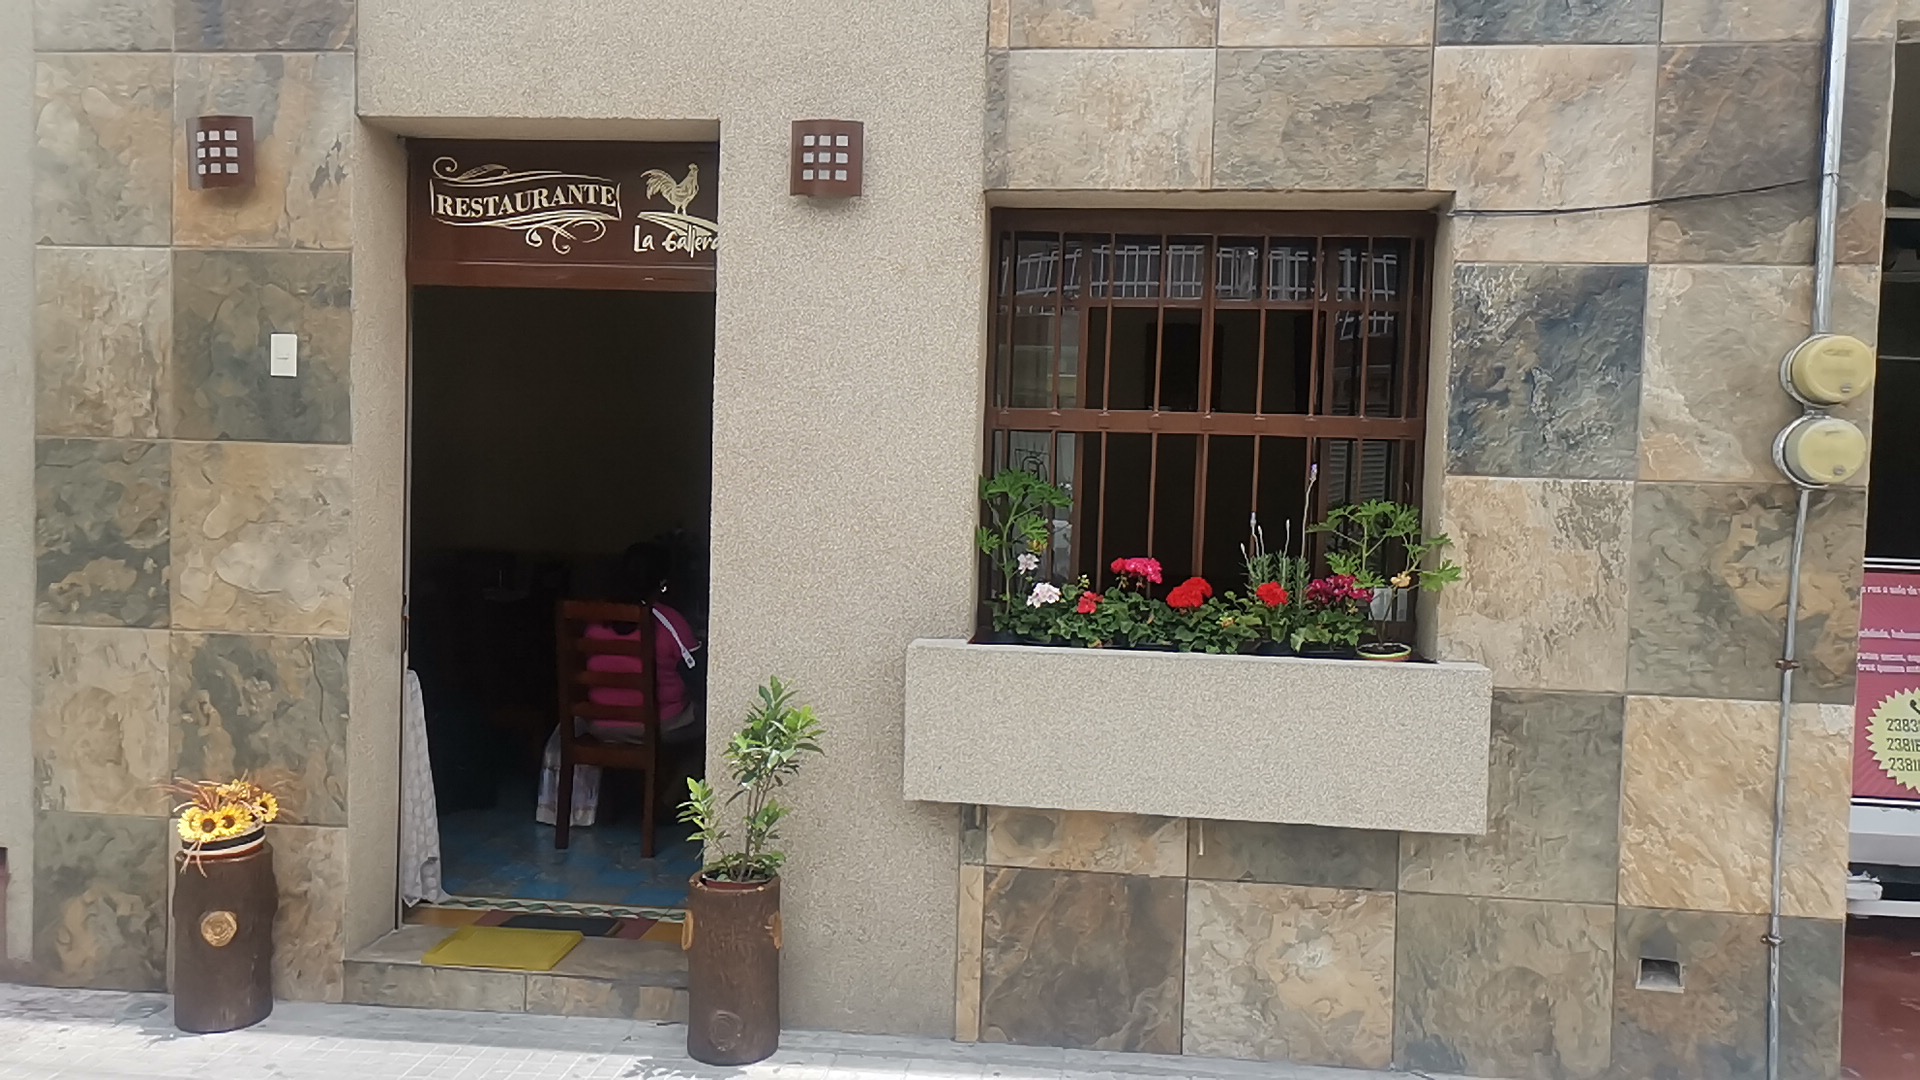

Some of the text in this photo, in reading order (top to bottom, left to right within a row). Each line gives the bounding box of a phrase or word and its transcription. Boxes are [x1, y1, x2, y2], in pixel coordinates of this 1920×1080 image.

[436, 184, 616, 218] RESTAURANTE
[633, 224, 656, 252] La
[1885, 718, 1920, 733] 2383
